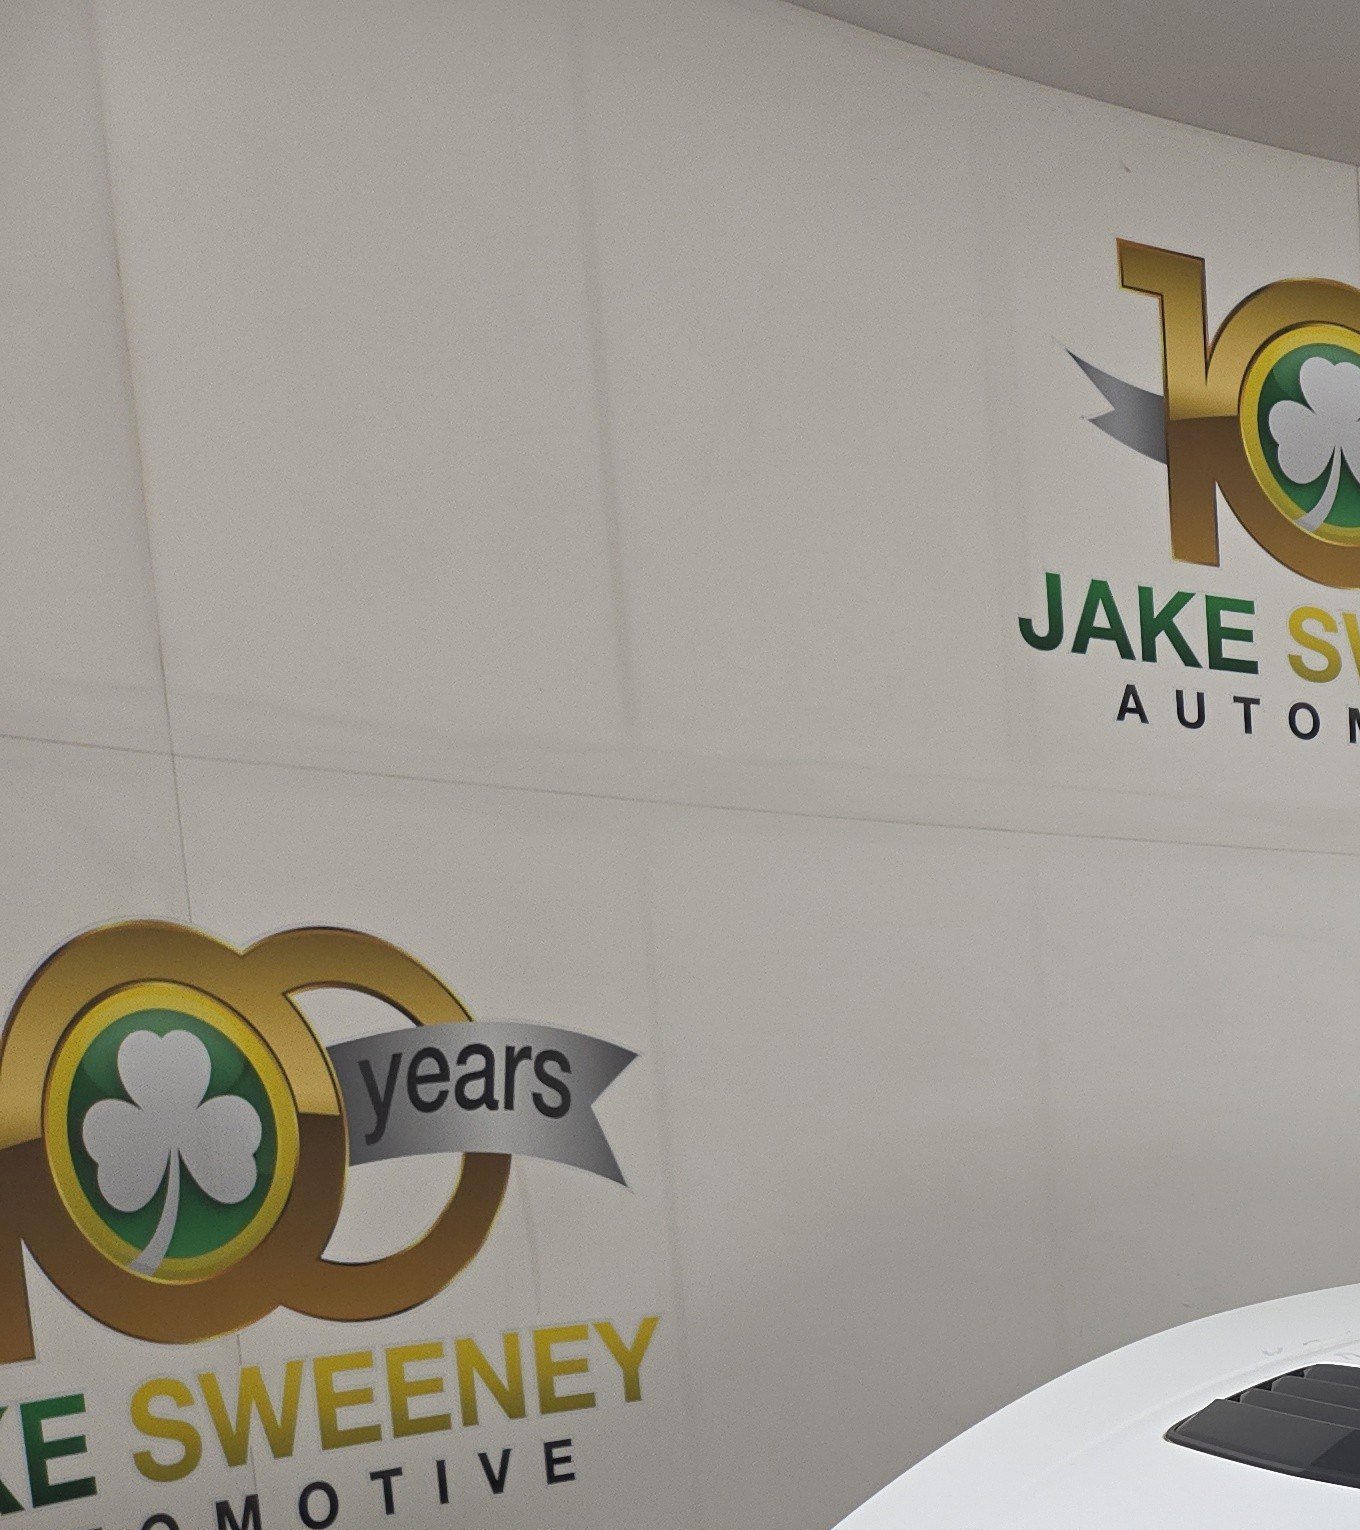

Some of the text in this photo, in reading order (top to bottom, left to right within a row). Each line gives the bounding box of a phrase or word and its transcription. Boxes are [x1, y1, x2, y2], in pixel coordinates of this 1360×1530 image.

[1017, 572, 1260, 675] JAKE
[358, 1043, 573, 1146] years
[130, 1317, 661, 1483] SWEENEY
